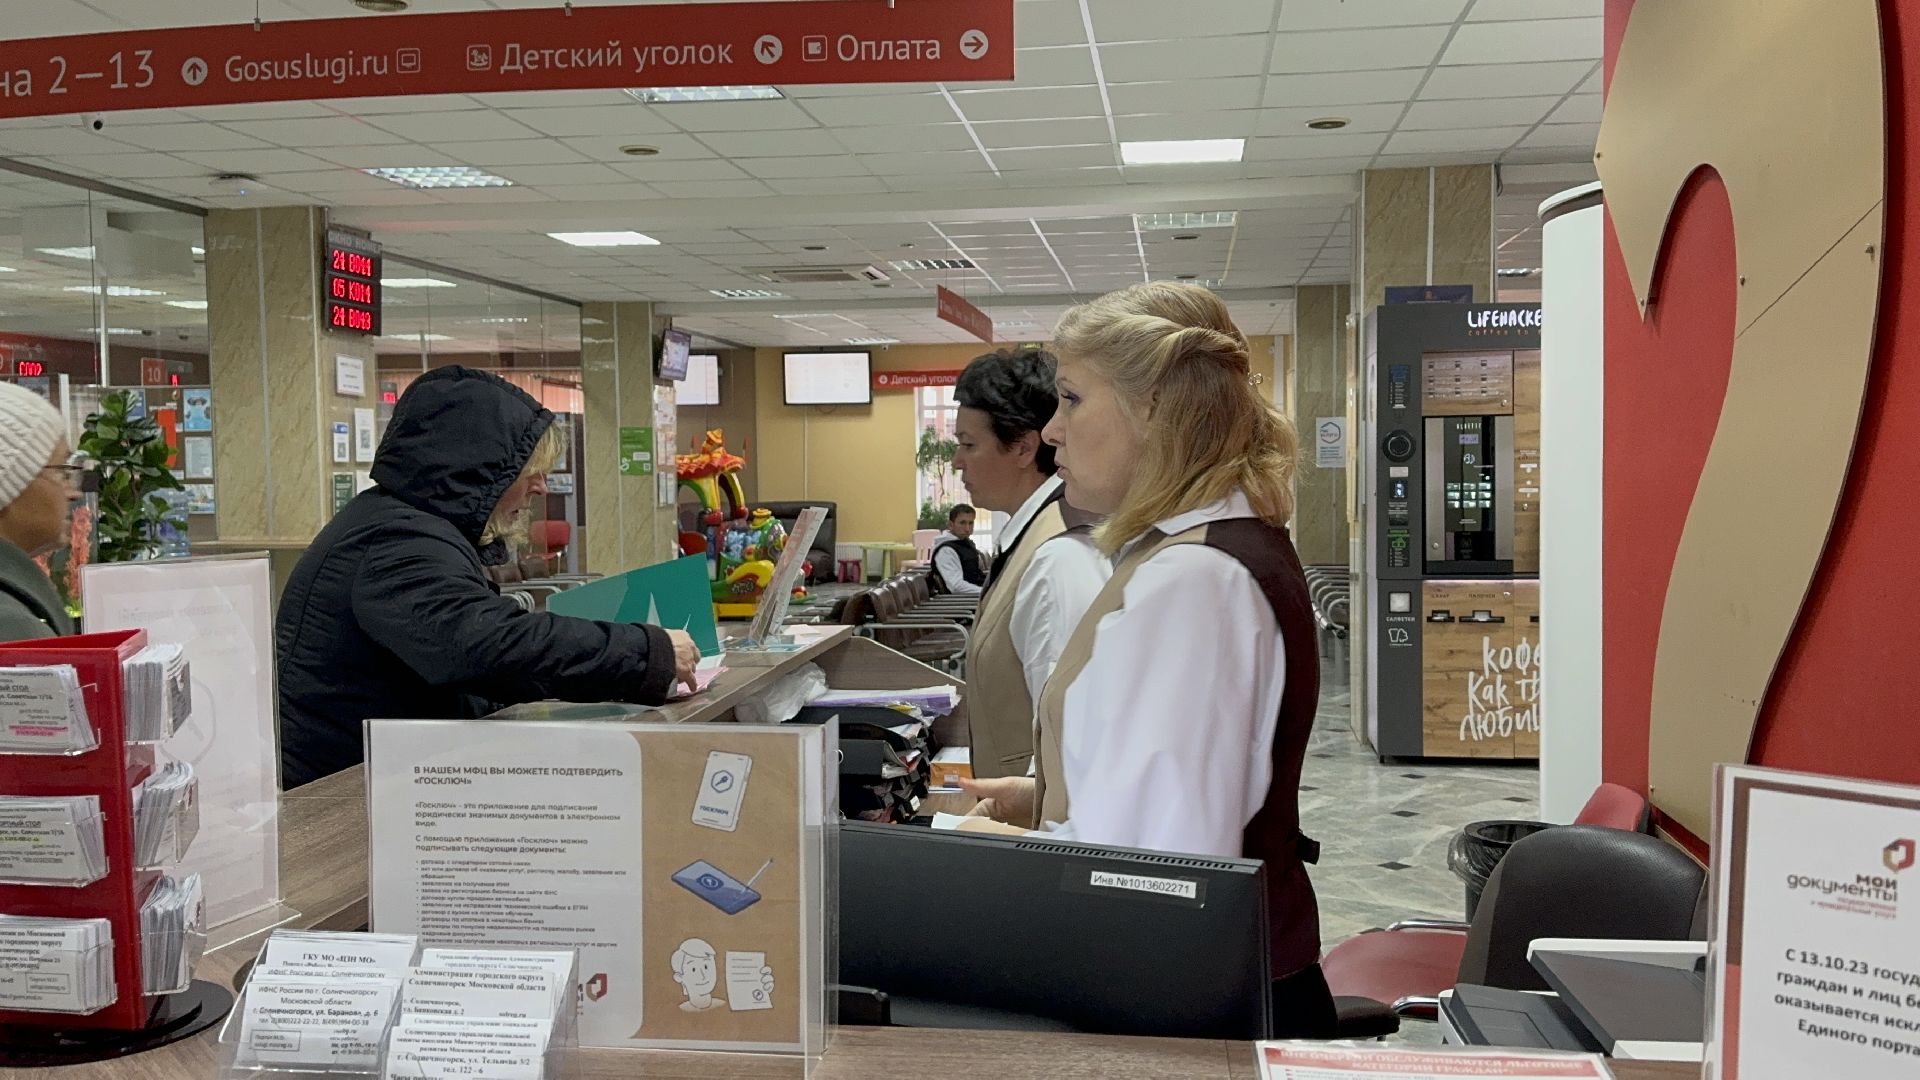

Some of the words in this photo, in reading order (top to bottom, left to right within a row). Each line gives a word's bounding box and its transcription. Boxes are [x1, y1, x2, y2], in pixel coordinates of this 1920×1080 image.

[836, 33, 941, 61] Оплата
[501, 39, 622, 75] Детский
[634, 43, 734, 73] уголок
[225, 51, 388, 84] Gosuslugi.ru
[147, 367, 160, 383] 10
[892, 375, 927, 385] Детский
[414, 766, 420, 774] В
[423, 766, 461, 774] НАШЕМ
[464, 767, 488, 776] МФЦ
[489, 767, 505, 775] ВЫ
[507, 767, 550, 776] МОЖЕТЕ
[552, 768, 623, 777] ПОДТВЕРДИТЬ
[414, 777, 472, 785] «ГОСКЛЮЧ»
[415, 801, 457, 809] «Госключ»
[415, 811, 466, 819] юридически
[509, 813, 558, 821] документов
[415, 834, 421, 842] С
[423, 835, 462, 843] помощью
[517, 836, 558, 844] «Госключ»
[415, 844, 470, 852] подписывать
[519, 846, 567, 854] документы:
[1094, 874, 1114, 885] Инв
[1116, 877, 1190, 894] №1013602271
[1787, 874, 1897, 902] документы
[303, 953, 319, 961] ГКУ
[322, 954, 335, 962] МО
[358, 956, 376, 964] МО»
[1785, 948, 1796, 961] С
[1800, 951, 1869, 975] 13.10.23
[413, 969, 473, 978] Администрация
[475, 971, 517, 980] городского
[518, 974, 544, 982] округа
[408, 979, 466, 988] Солнечногорск
[468, 981, 514, 990] Московской
[516, 983, 546, 991] области
[1777, 972, 1848, 995] граждан
[1853, 986, 1864, 997] и
[1868, 989, 1902, 1008] лиц
[322, 988, 378, 996] Солнечногорску
[280, 997, 323, 1005] Московской
[324, 998, 352, 1006] области
[410, 997, 462, 1007] Солнечногорск,
[259, 1007, 313, 1016] Солнечногорск,
[315, 1008, 326, 1016] ул.
[414, 1007, 452, 1015] Банковская
[1774, 994, 1880, 1024] оказывается
[1798, 1018, 1868, 1045] Единого
[1872, 1036, 1920, 1056] порта
[405, 1053, 466, 1064] Солнечногорск,
[1376, 1054, 1502, 1066] ОБСЛУЖИВАЮТСЯ
[1506, 1060, 1584, 1069] ЛЬГОТНЫЕ
[1351, 1062, 1433, 1072] КАТЕГОРИИ
